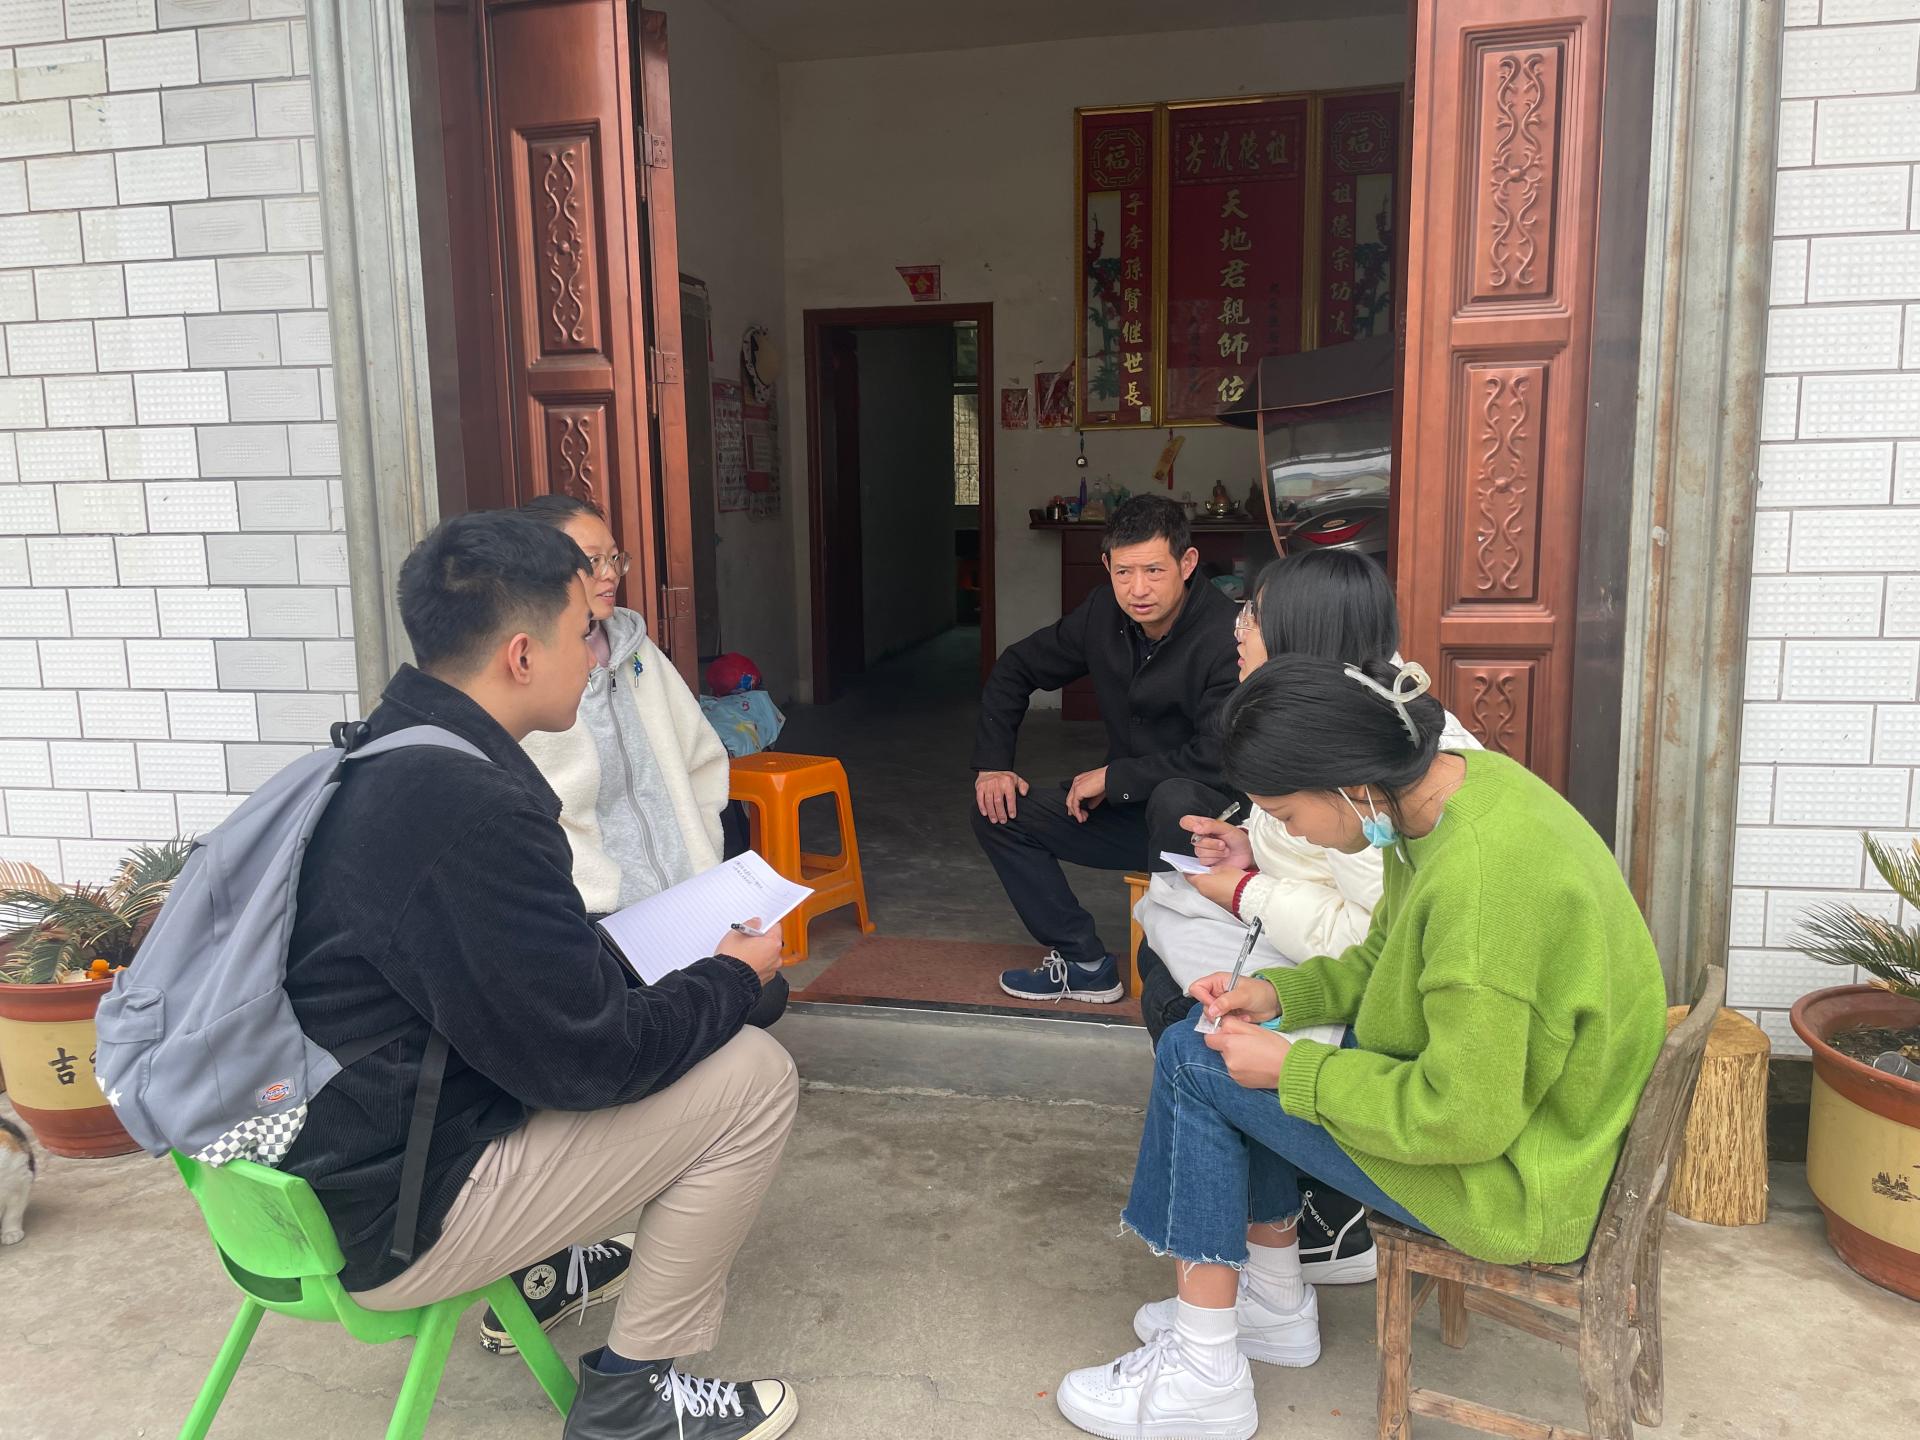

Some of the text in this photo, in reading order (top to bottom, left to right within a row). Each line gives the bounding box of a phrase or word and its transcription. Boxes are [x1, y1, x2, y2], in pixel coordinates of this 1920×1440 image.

[1346, 127, 1375, 153] 福
[1104, 144, 1130, 170] 福
[1216, 188, 1252, 403] 天地君親師位
[48, 1047, 78, 1085] 吉
